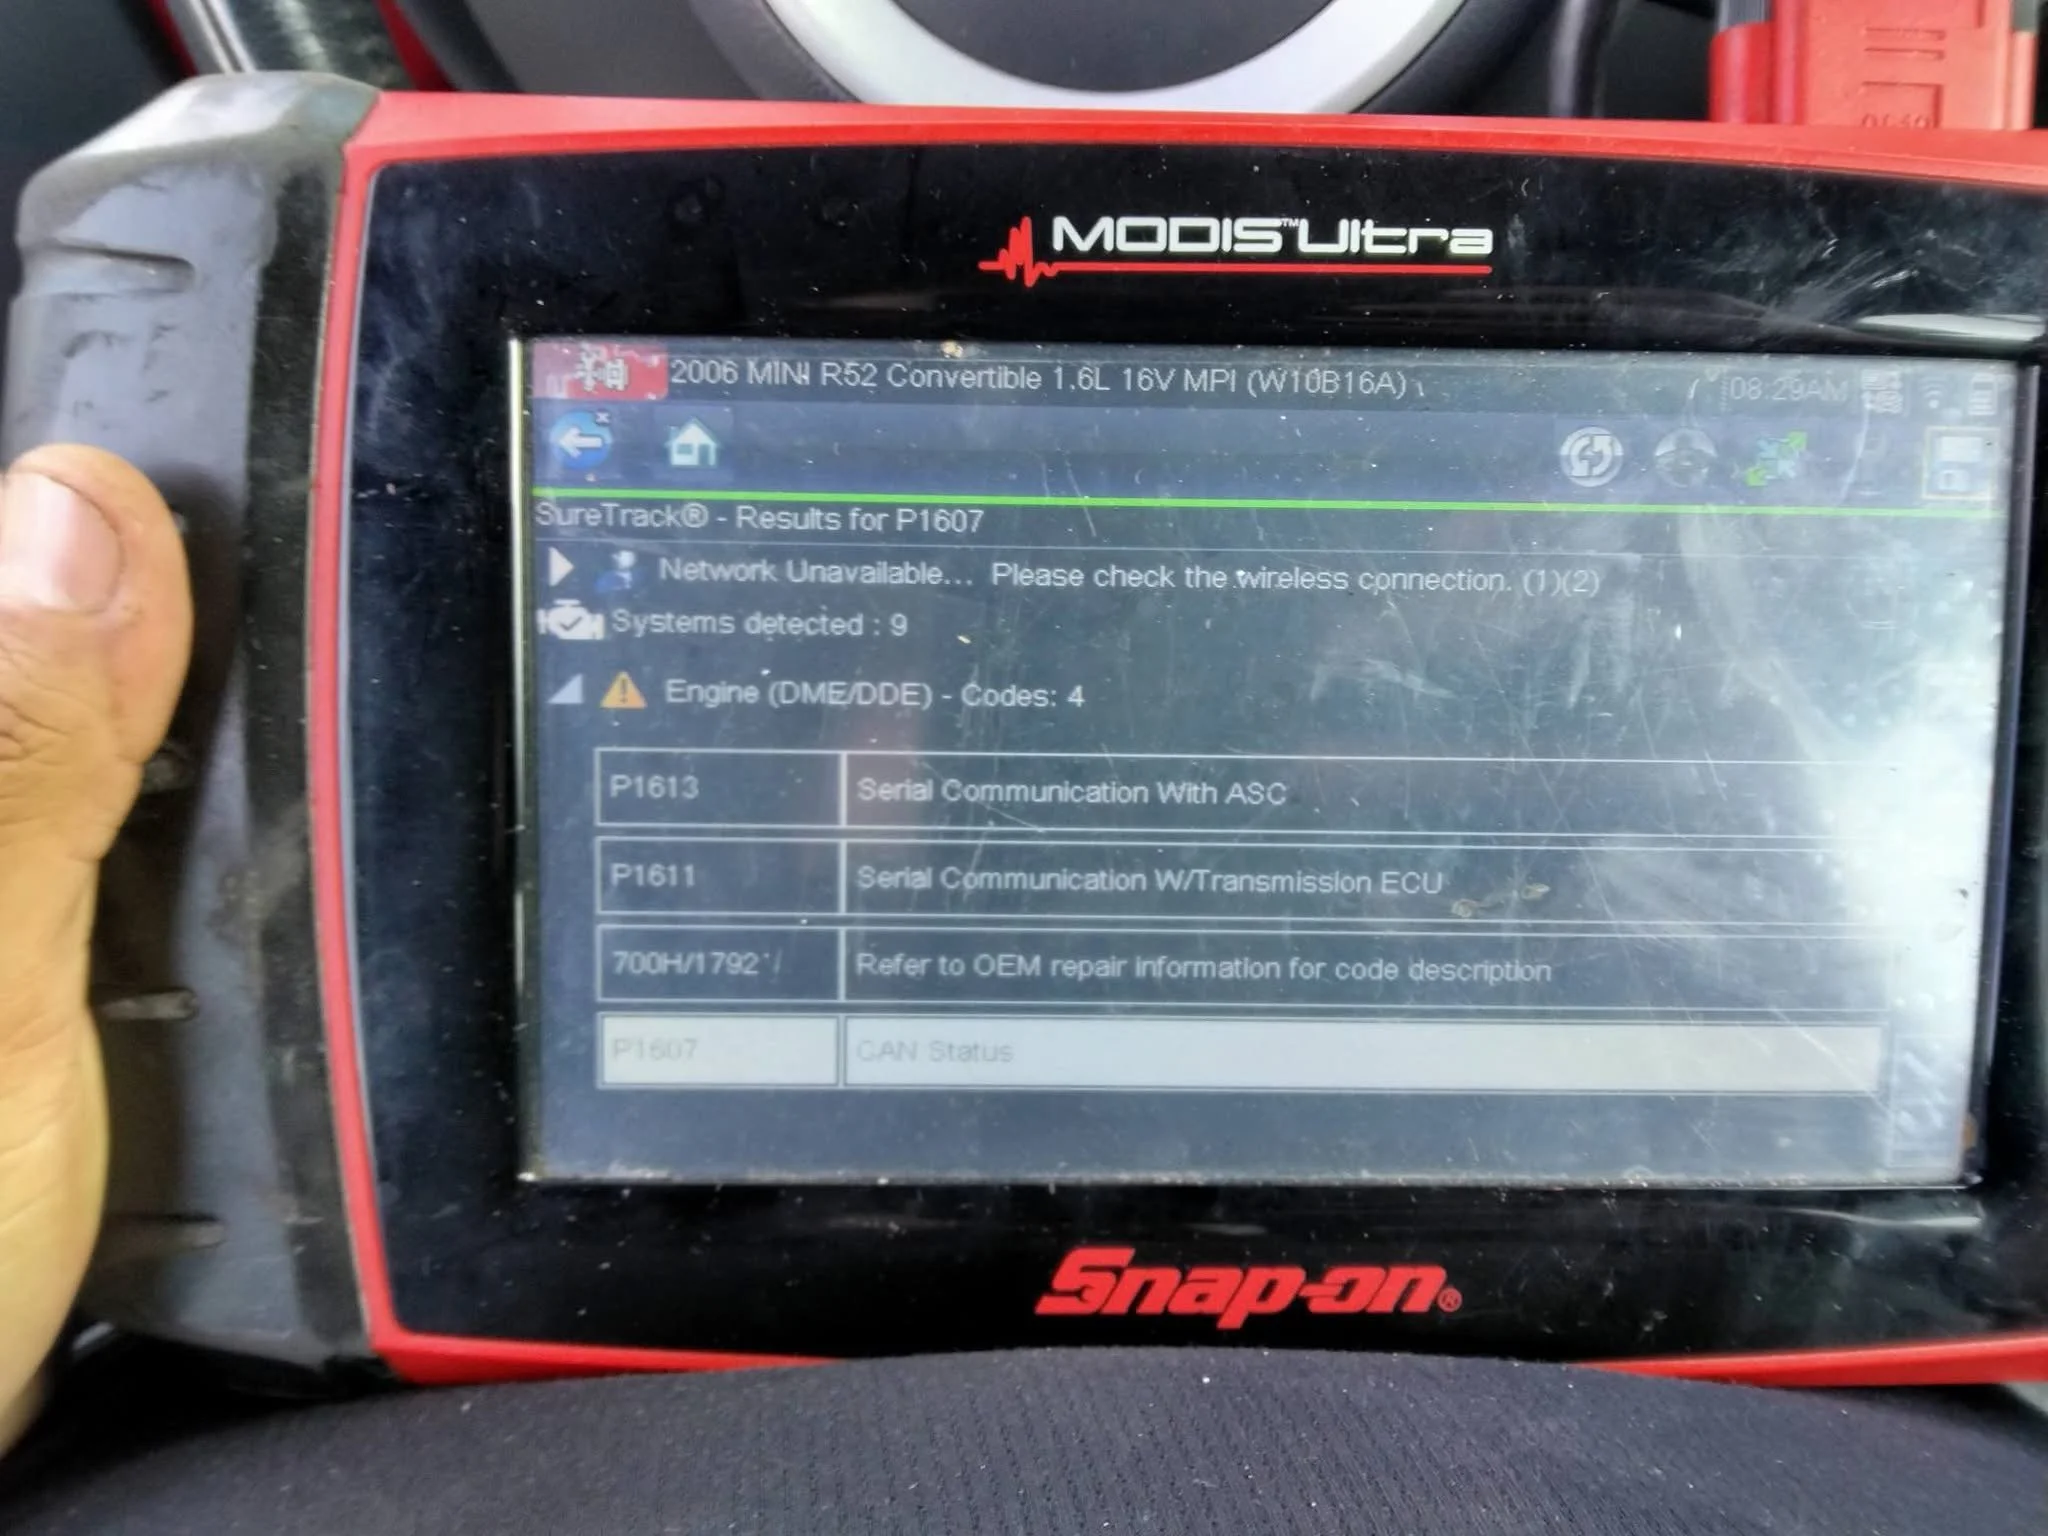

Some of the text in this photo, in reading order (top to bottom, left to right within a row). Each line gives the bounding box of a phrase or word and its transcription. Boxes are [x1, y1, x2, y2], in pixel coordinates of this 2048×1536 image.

[1299, 217, 1494, 256] Ultra
[670, 358, 1408, 400] 2006 MINI R52 Convertible 1.6L 16V MPI (W10B16A)
[735, 504, 842, 532] Results
[849, 507, 889, 533] for
[896, 508, 985, 534] P1607
[659, 556, 1600, 598] Network Unavailable... Please check the wireless connection. (1)(2)
[612, 608, 736, 640] Systems
[744, 612, 864, 637] detected
[889, 614, 909, 637] 9
[665, 679, 759, 707] Engine
[768, 680, 933, 710] (DME/DDE)
[960, 683, 1058, 709] Codes:
[1066, 684, 1086, 709] 4
[609, 774, 699, 800] P1613
[857, 777, 1288, 806] Serial Communication With ASC
[609, 862, 697, 889] P1611
[857, 864, 1444, 895] Serial Communication W/Transmission ECU
[612, 950, 760, 977] 700H/1792
[856, 953, 1553, 988] Refer to OEM repair information for code description
[612, 1038, 698, 1062] P1607
[856, 1037, 1014, 1065] CAN Status
